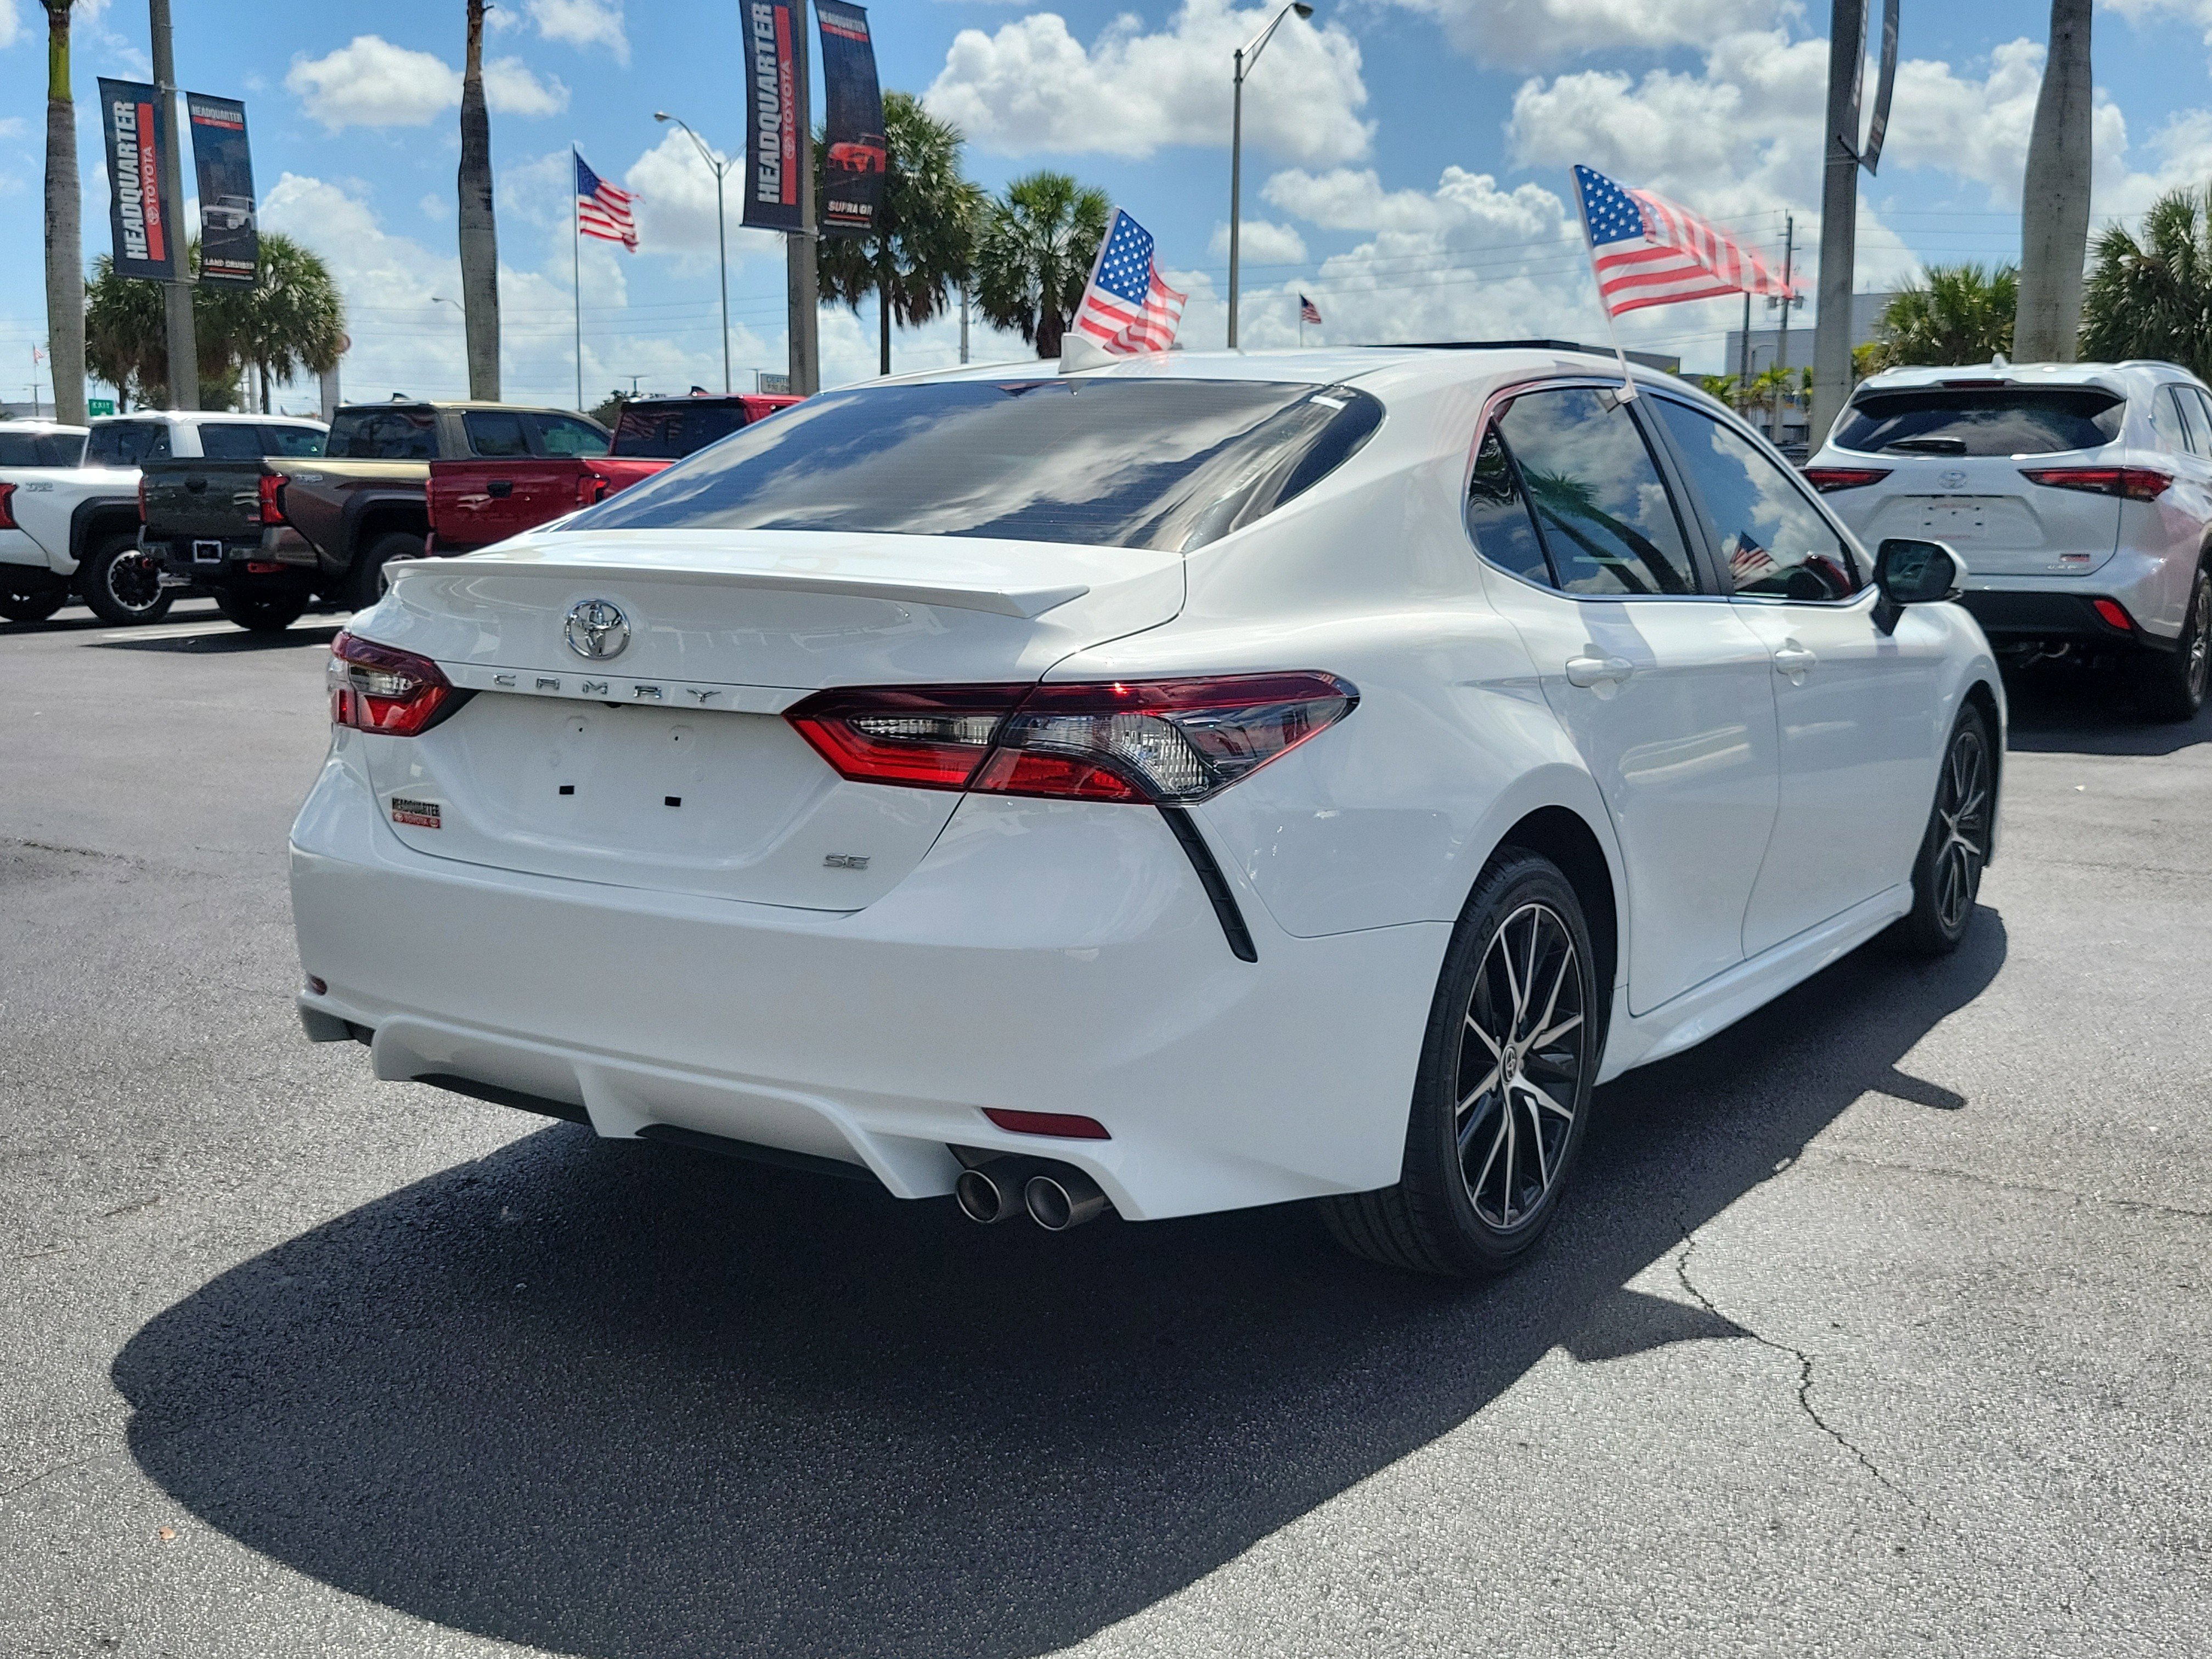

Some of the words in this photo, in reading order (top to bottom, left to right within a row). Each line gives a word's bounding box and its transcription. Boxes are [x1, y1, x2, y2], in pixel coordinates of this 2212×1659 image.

[752, 3, 782, 204] HEADQUARTER
[780, 60, 794, 132] TOYOTA
[114, 101, 148, 259] HEADQUARTER
[143, 146, 157, 205] TOYOTA
[828, 200, 858, 214] SUPRA
[494, 673, 721, 702] CAMRY
[823, 853, 871, 870] SE
